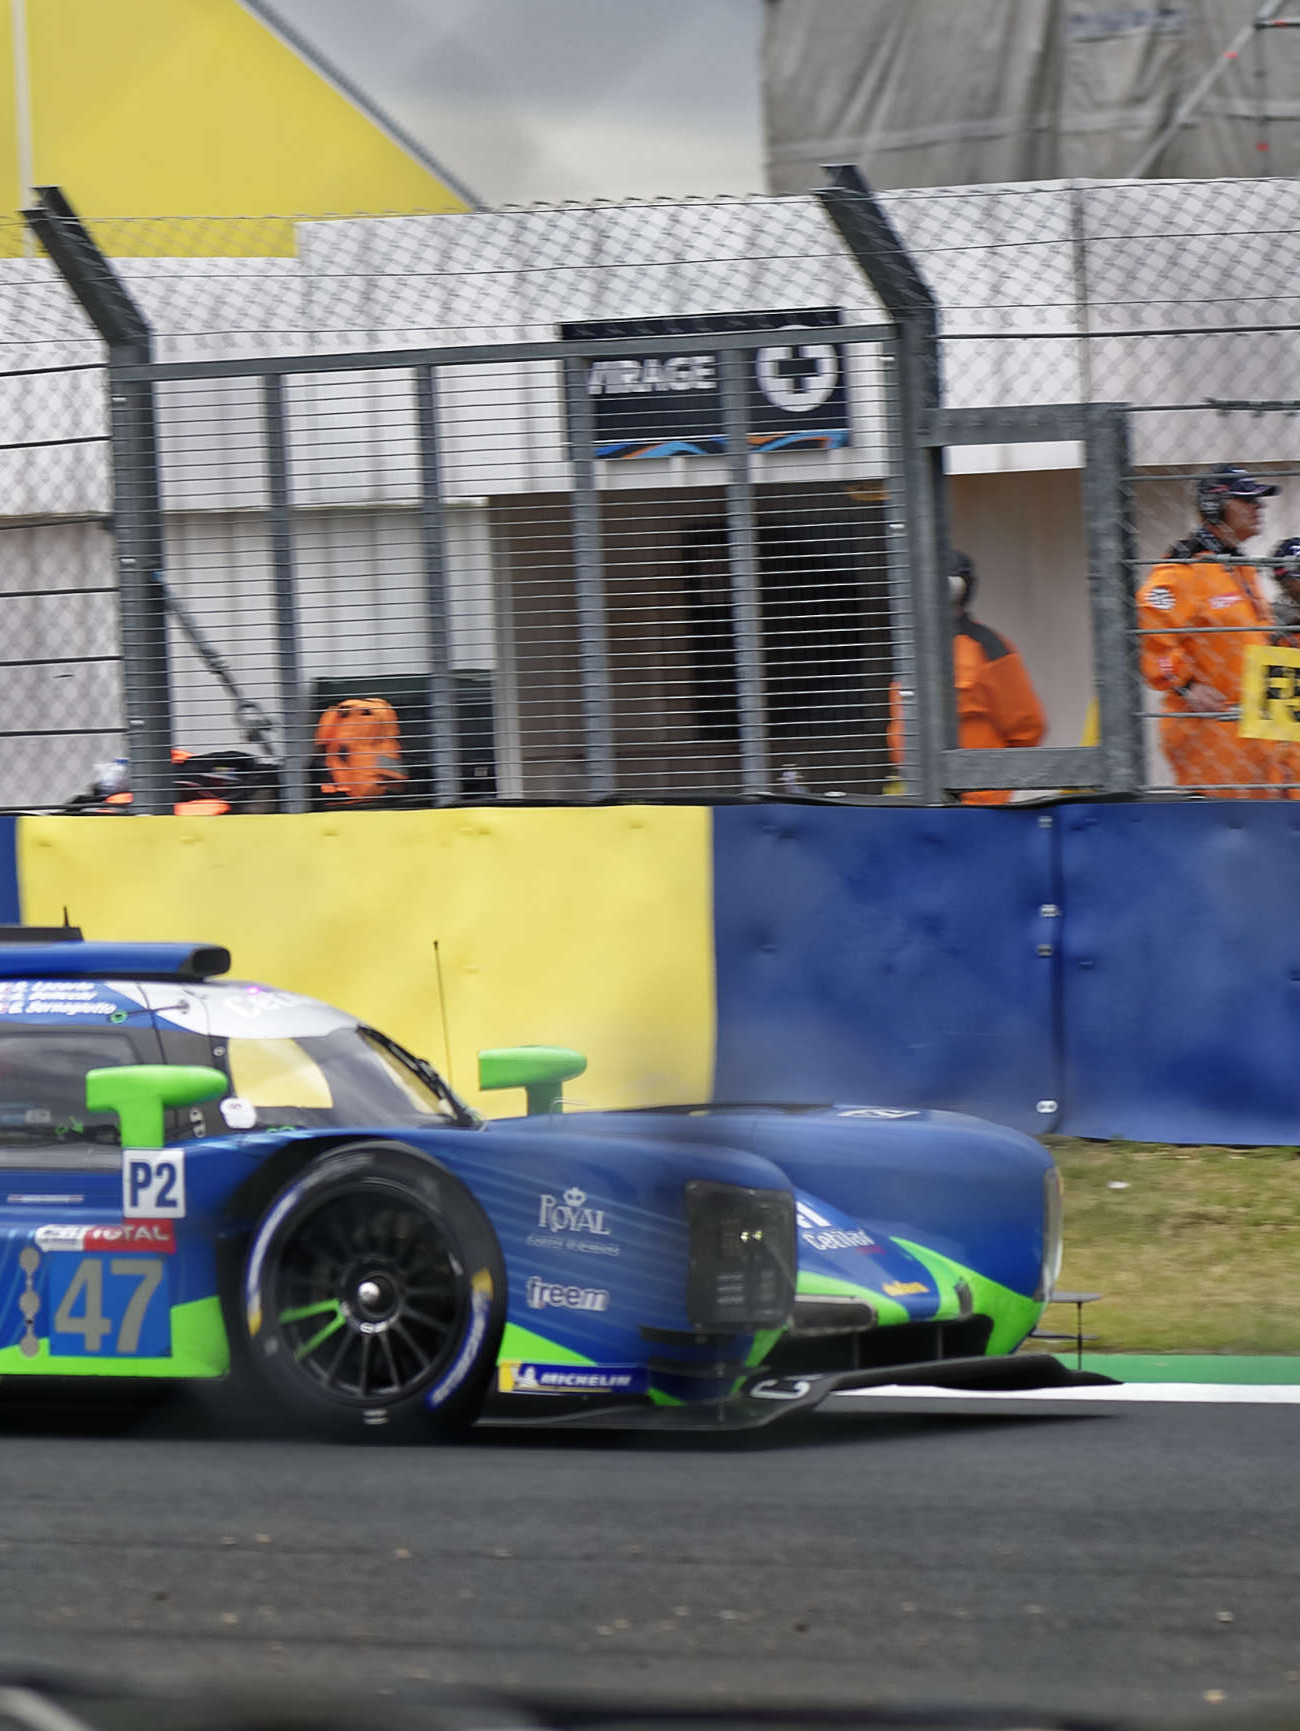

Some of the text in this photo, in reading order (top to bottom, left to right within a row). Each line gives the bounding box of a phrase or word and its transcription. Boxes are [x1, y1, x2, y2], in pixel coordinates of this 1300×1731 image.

[129, 1162, 178, 1208] P2
[91, 1225, 170, 1241] TOTAL
[539, 1194, 611, 1235] ROYAL
[54, 1258, 164, 1354] 47
[540, 1371, 632, 1387] MICHELIN
